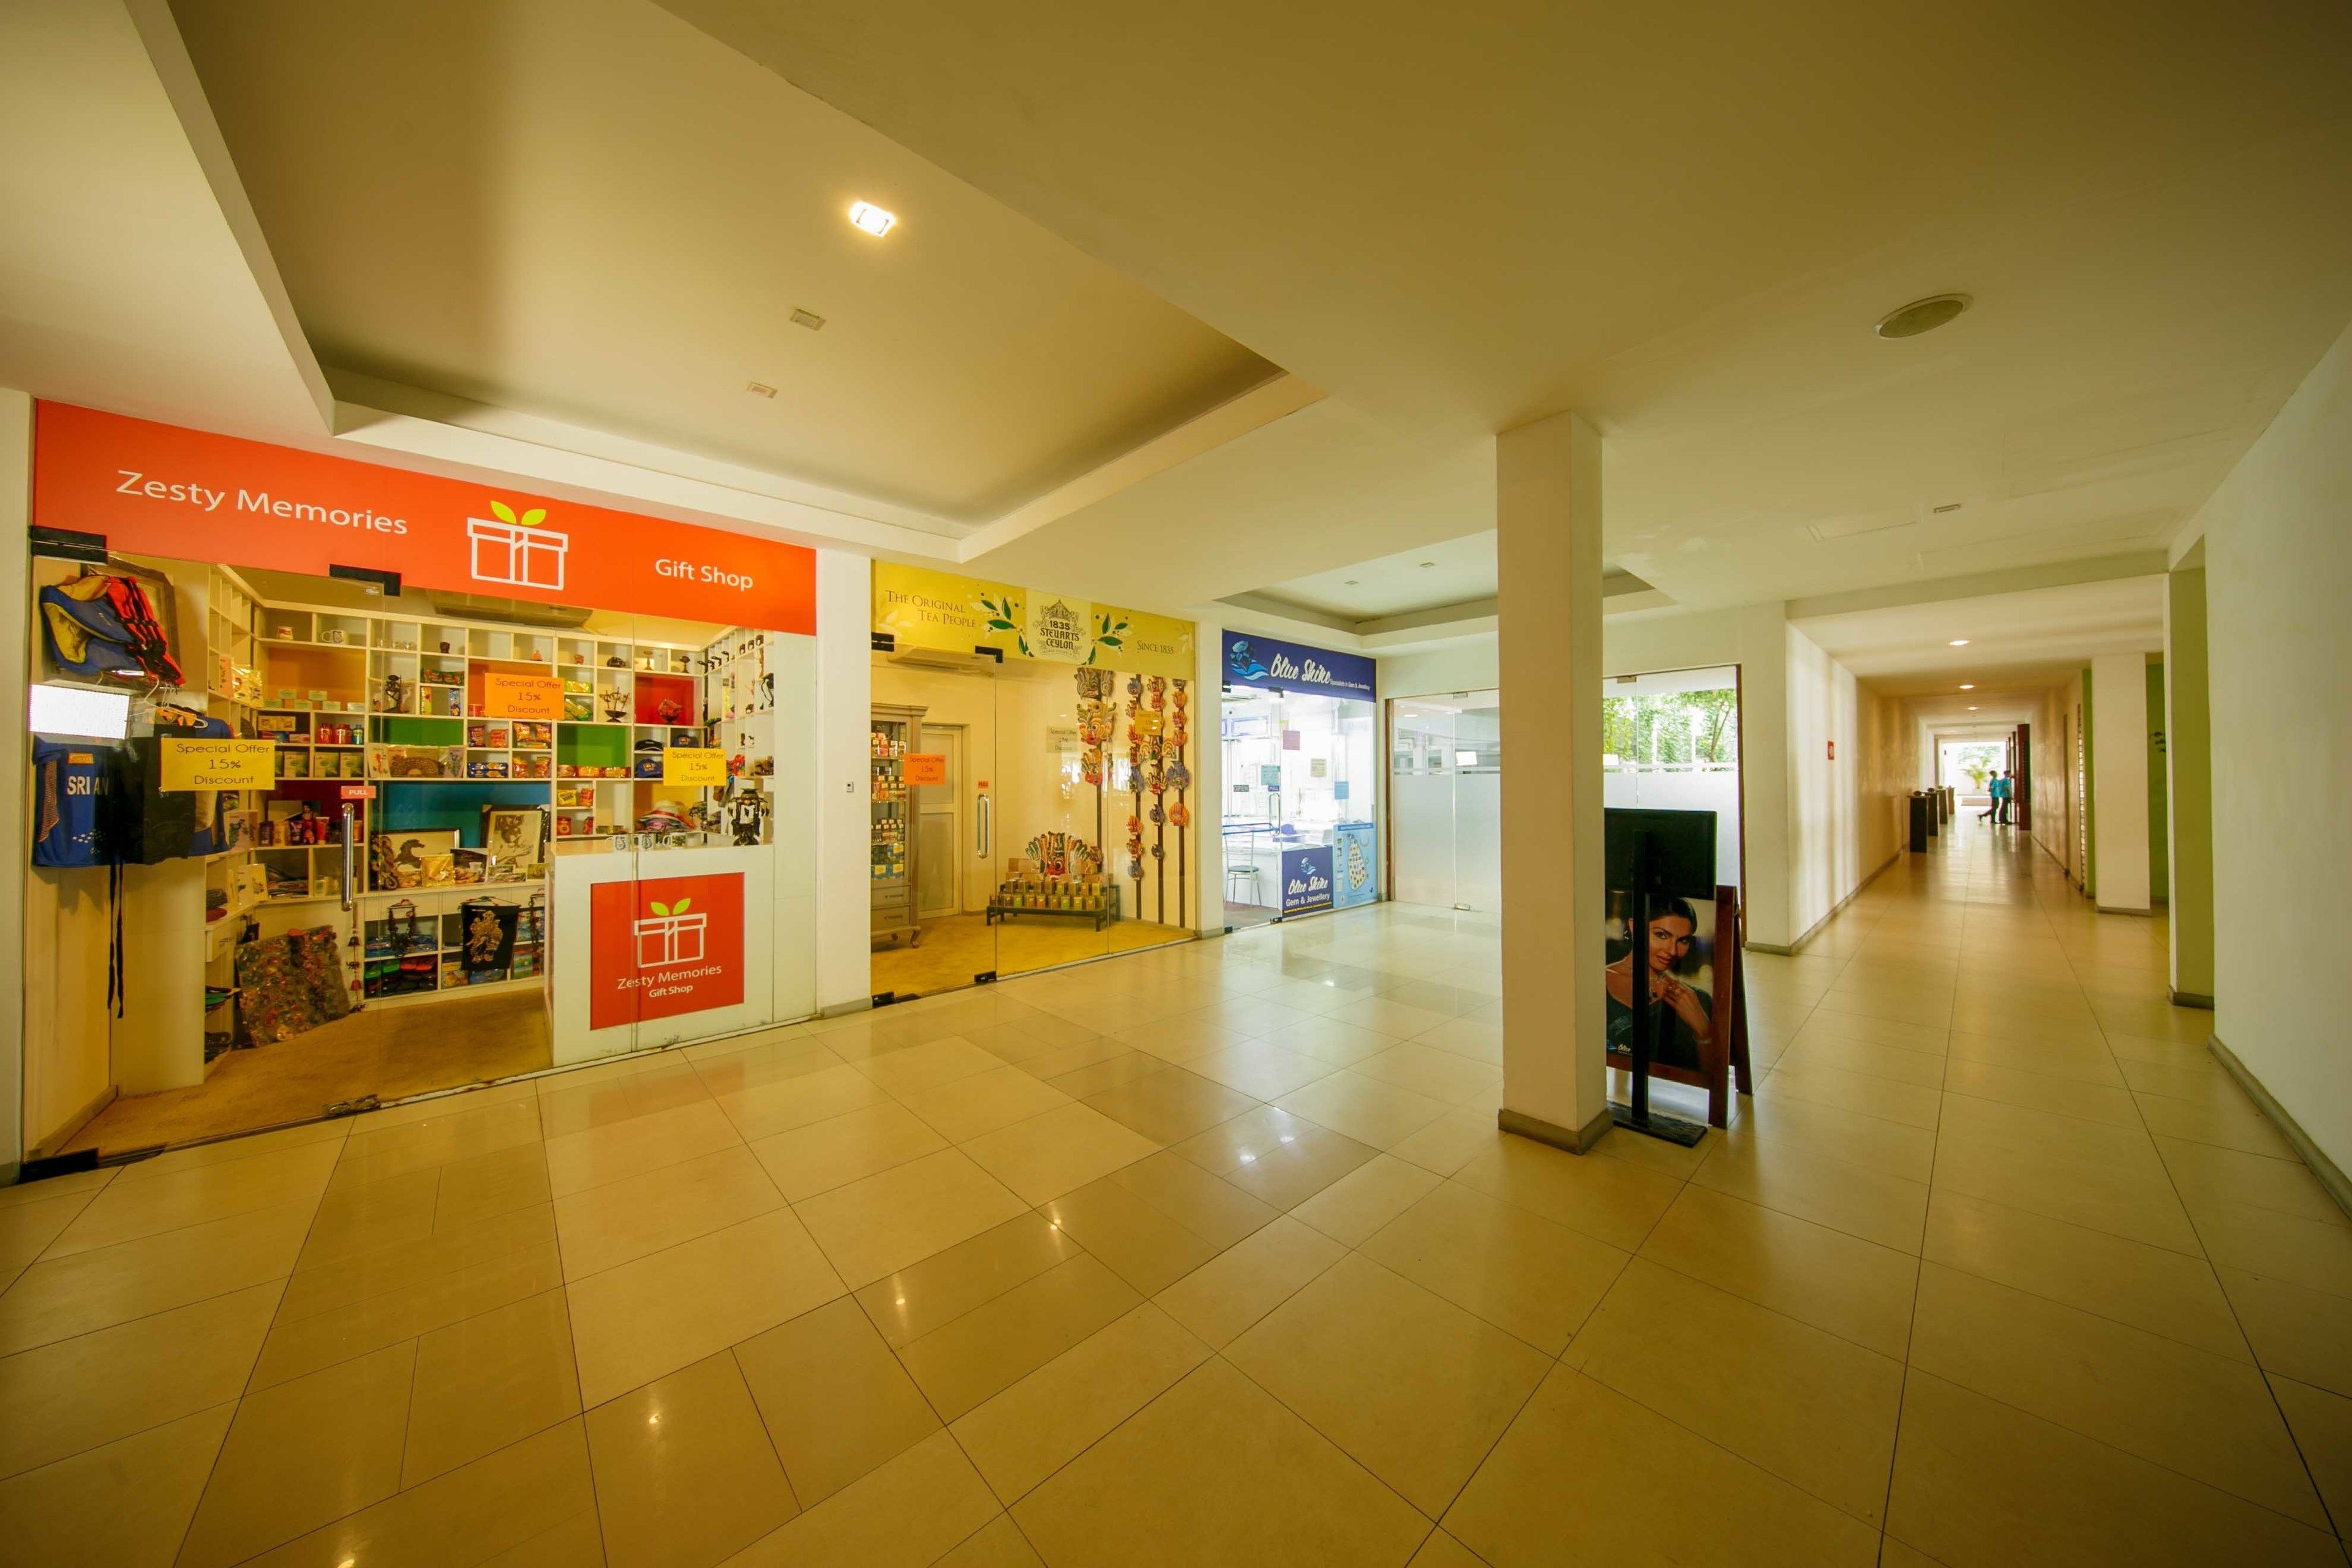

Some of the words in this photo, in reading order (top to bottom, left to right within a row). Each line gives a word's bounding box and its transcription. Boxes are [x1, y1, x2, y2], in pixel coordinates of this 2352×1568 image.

[116, 469, 225, 511] Zesty
[236, 489, 408, 535] Memories
[655, 559, 695, 580] Gift
[701, 565, 753, 592] Shop
[885, 590, 909, 604] THE
[912, 595, 965, 613] ORIGINAL
[918, 609, 939, 623] TEA
[943, 613, 976, 628] PEOPLE
[1049, 620, 1071, 631] 1835
[1040, 627, 1080, 642] STEUARTS
[1046, 638, 1074, 650] CEYLON
[1137, 640, 1158, 652] SINCE
[1160, 644, 1174, 655] 1835
[1270, 653, 1299, 680] Blue
[1302, 658, 1331, 684] Shine
[496, 678, 533, 687] Special
[537, 680, 561, 689] Offer
[518, 692, 541, 701] 15%
[508, 704, 550, 714] Discount
[176, 743, 231, 755] Special
[235, 744, 270, 753] Offer
[672, 751, 702, 760] Special
[208, 759, 242, 770] 15%
[67, 775, 91, 796] SRI
[194, 775, 254, 785] Discount
[1288, 878, 1307, 895] Blue
[1308, 876, 1329, 892] Shine
[1286, 898, 1299, 907] Gem
[1306, 893, 1330, 903] Jewellery
[617, 975, 655, 990] Zesty
[658, 965, 722, 984] Memories
[649, 987, 667, 998] Gift
[668, 984, 693, 995] Shop
